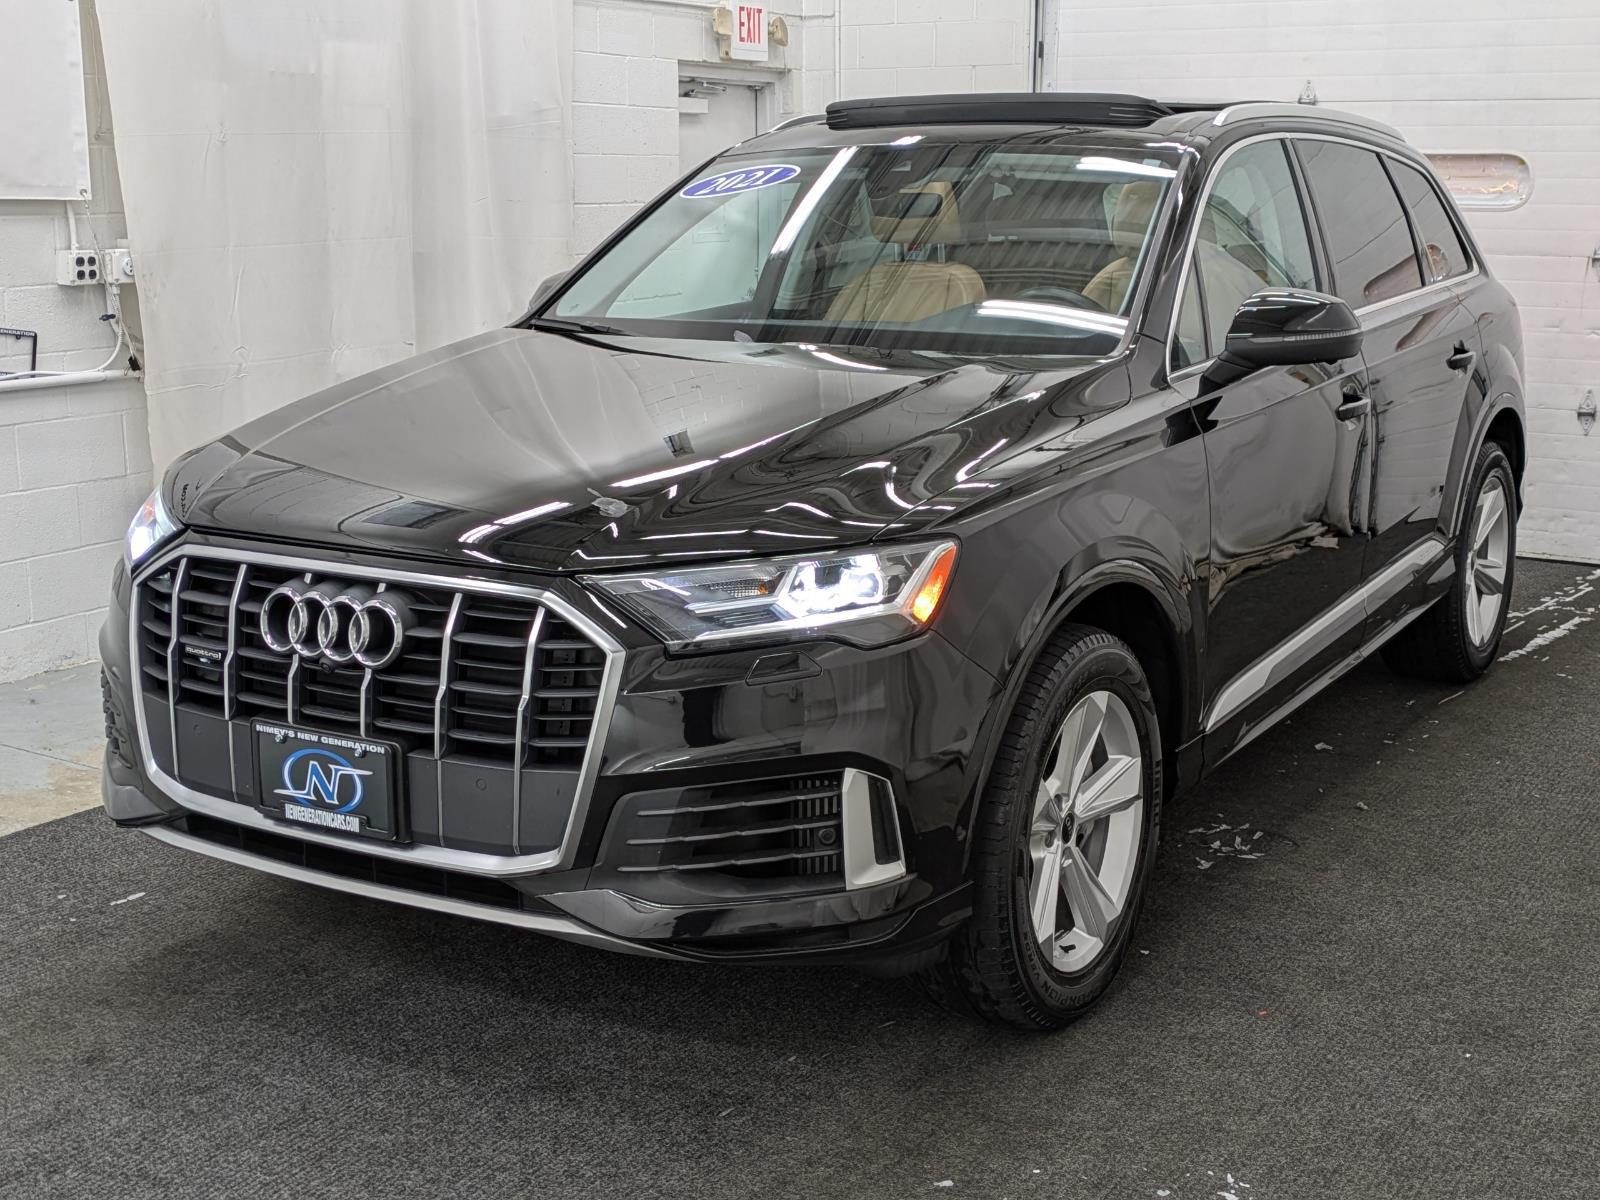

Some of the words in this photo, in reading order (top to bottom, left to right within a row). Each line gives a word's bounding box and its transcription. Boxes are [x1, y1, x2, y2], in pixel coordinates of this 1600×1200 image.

[738, 6, 763, 44] EXIT
[693, 167, 784, 196] 2021
[255, 724, 295, 738] NIMEY'S
[297, 732, 319, 743] NEW
[320, 736, 385, 754] GENERATION
[285, 803, 360, 833] NEWGENERATIONCARS.COM
